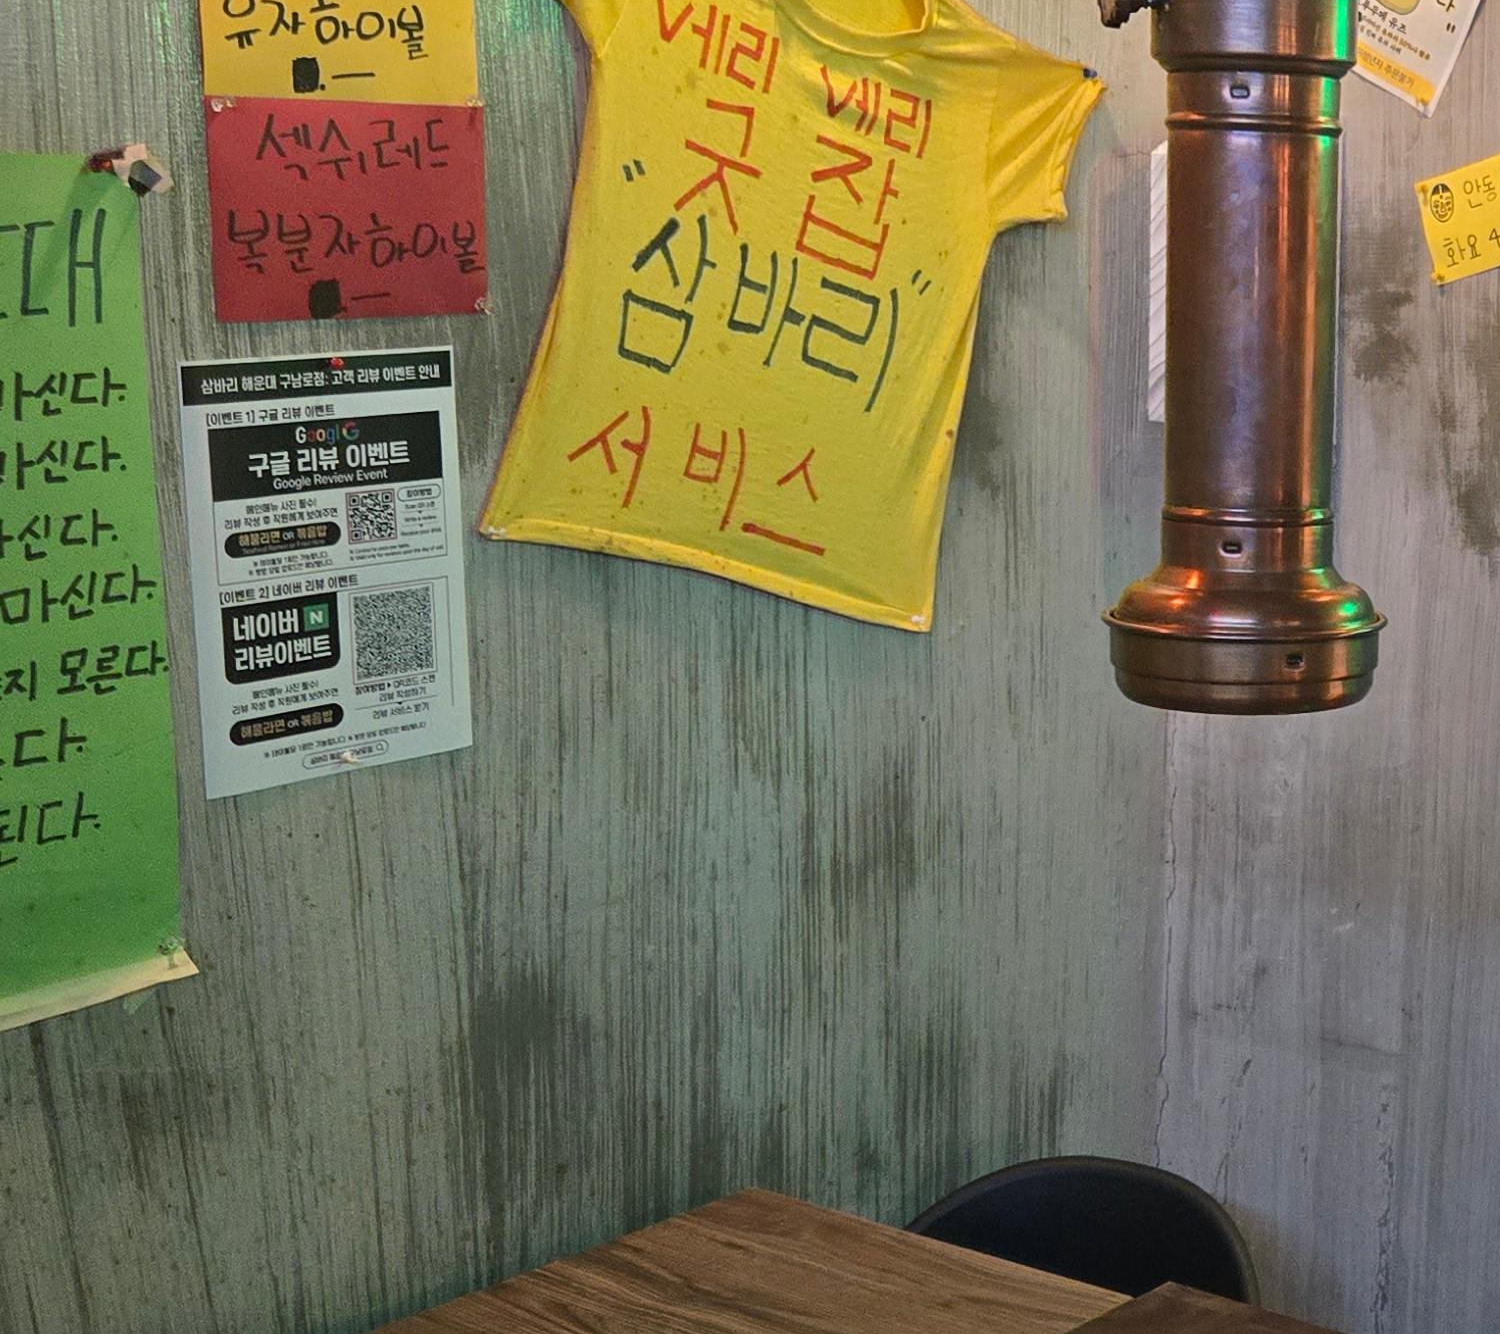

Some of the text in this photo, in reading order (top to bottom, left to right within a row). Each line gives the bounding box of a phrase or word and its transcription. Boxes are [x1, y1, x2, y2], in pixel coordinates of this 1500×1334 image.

[1443, 234, 1482, 268] 화요
[201, 377, 238, 395] 삼바리
[241, 375, 277, 392] 해운대
[357, 368, 380, 383] 리뷰
[383, 365, 417, 382] 이벤트
[418, 364, 440, 380] 안내
[259, 408, 278, 422] 구글
[282, 406, 301, 420] 리뷰
[304, 404, 335, 418] 이벤트
[248, 440, 410, 478] 구글 리뷰 이벤트
[273, 469, 388, 490] Google Review Event
[567, 404, 827, 557] 서비스
[272, 581, 303, 596] 네이버
[305, 578, 325, 592] 리뷰
[328, 574, 359, 589] 이벤트
[233, 608, 299, 641] 네이버
[234, 634, 332, 671] 리뷰이벤트
